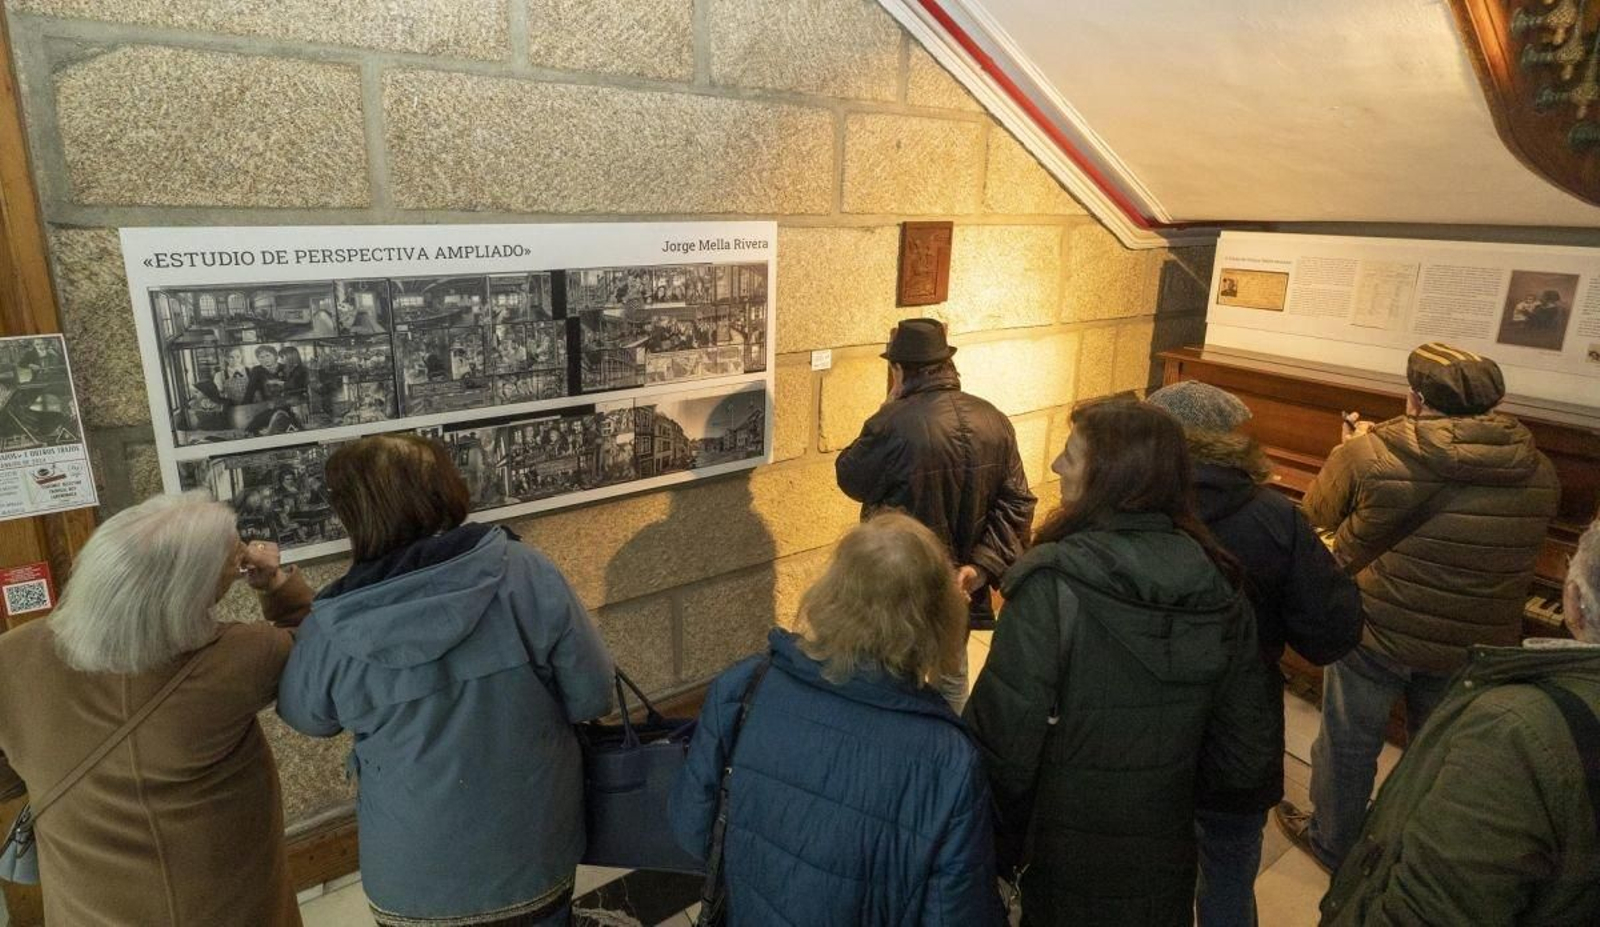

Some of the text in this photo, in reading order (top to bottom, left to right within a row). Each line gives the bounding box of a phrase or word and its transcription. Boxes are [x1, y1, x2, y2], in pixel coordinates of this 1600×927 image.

[142, 243, 532, 269] «ESTUDIO DE PERSPECTIVA AMPLIADO»
[661, 238, 769, 254] Jorge Mella Rivera
